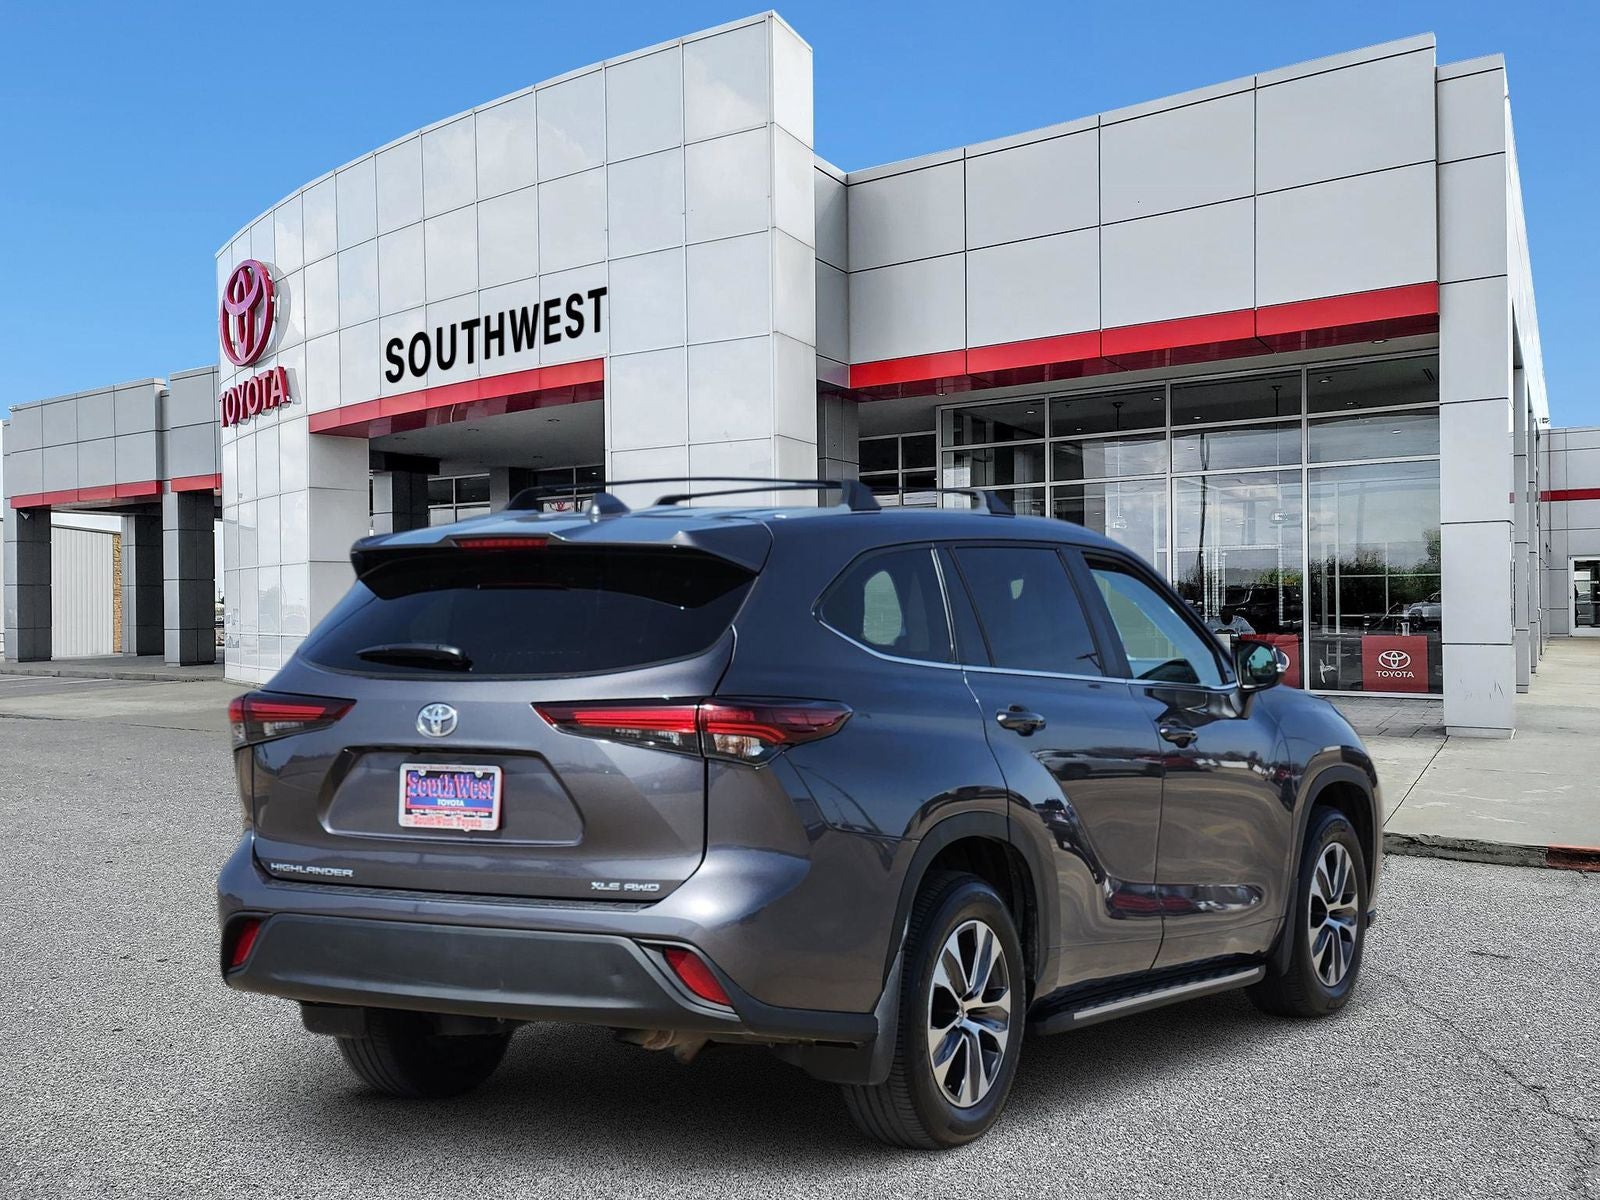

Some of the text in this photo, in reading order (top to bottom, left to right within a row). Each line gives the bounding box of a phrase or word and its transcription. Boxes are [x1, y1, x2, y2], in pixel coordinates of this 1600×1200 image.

[385, 286, 608, 384] SOUTHWEST
[219, 366, 290, 428] TOYOTA
[1376, 670, 1415, 678] TOYOTA
[437, 799, 465, 807] TOYOTA
[270, 862, 354, 878] HIGHLANDER
[591, 881, 660, 892] XLE AWD
